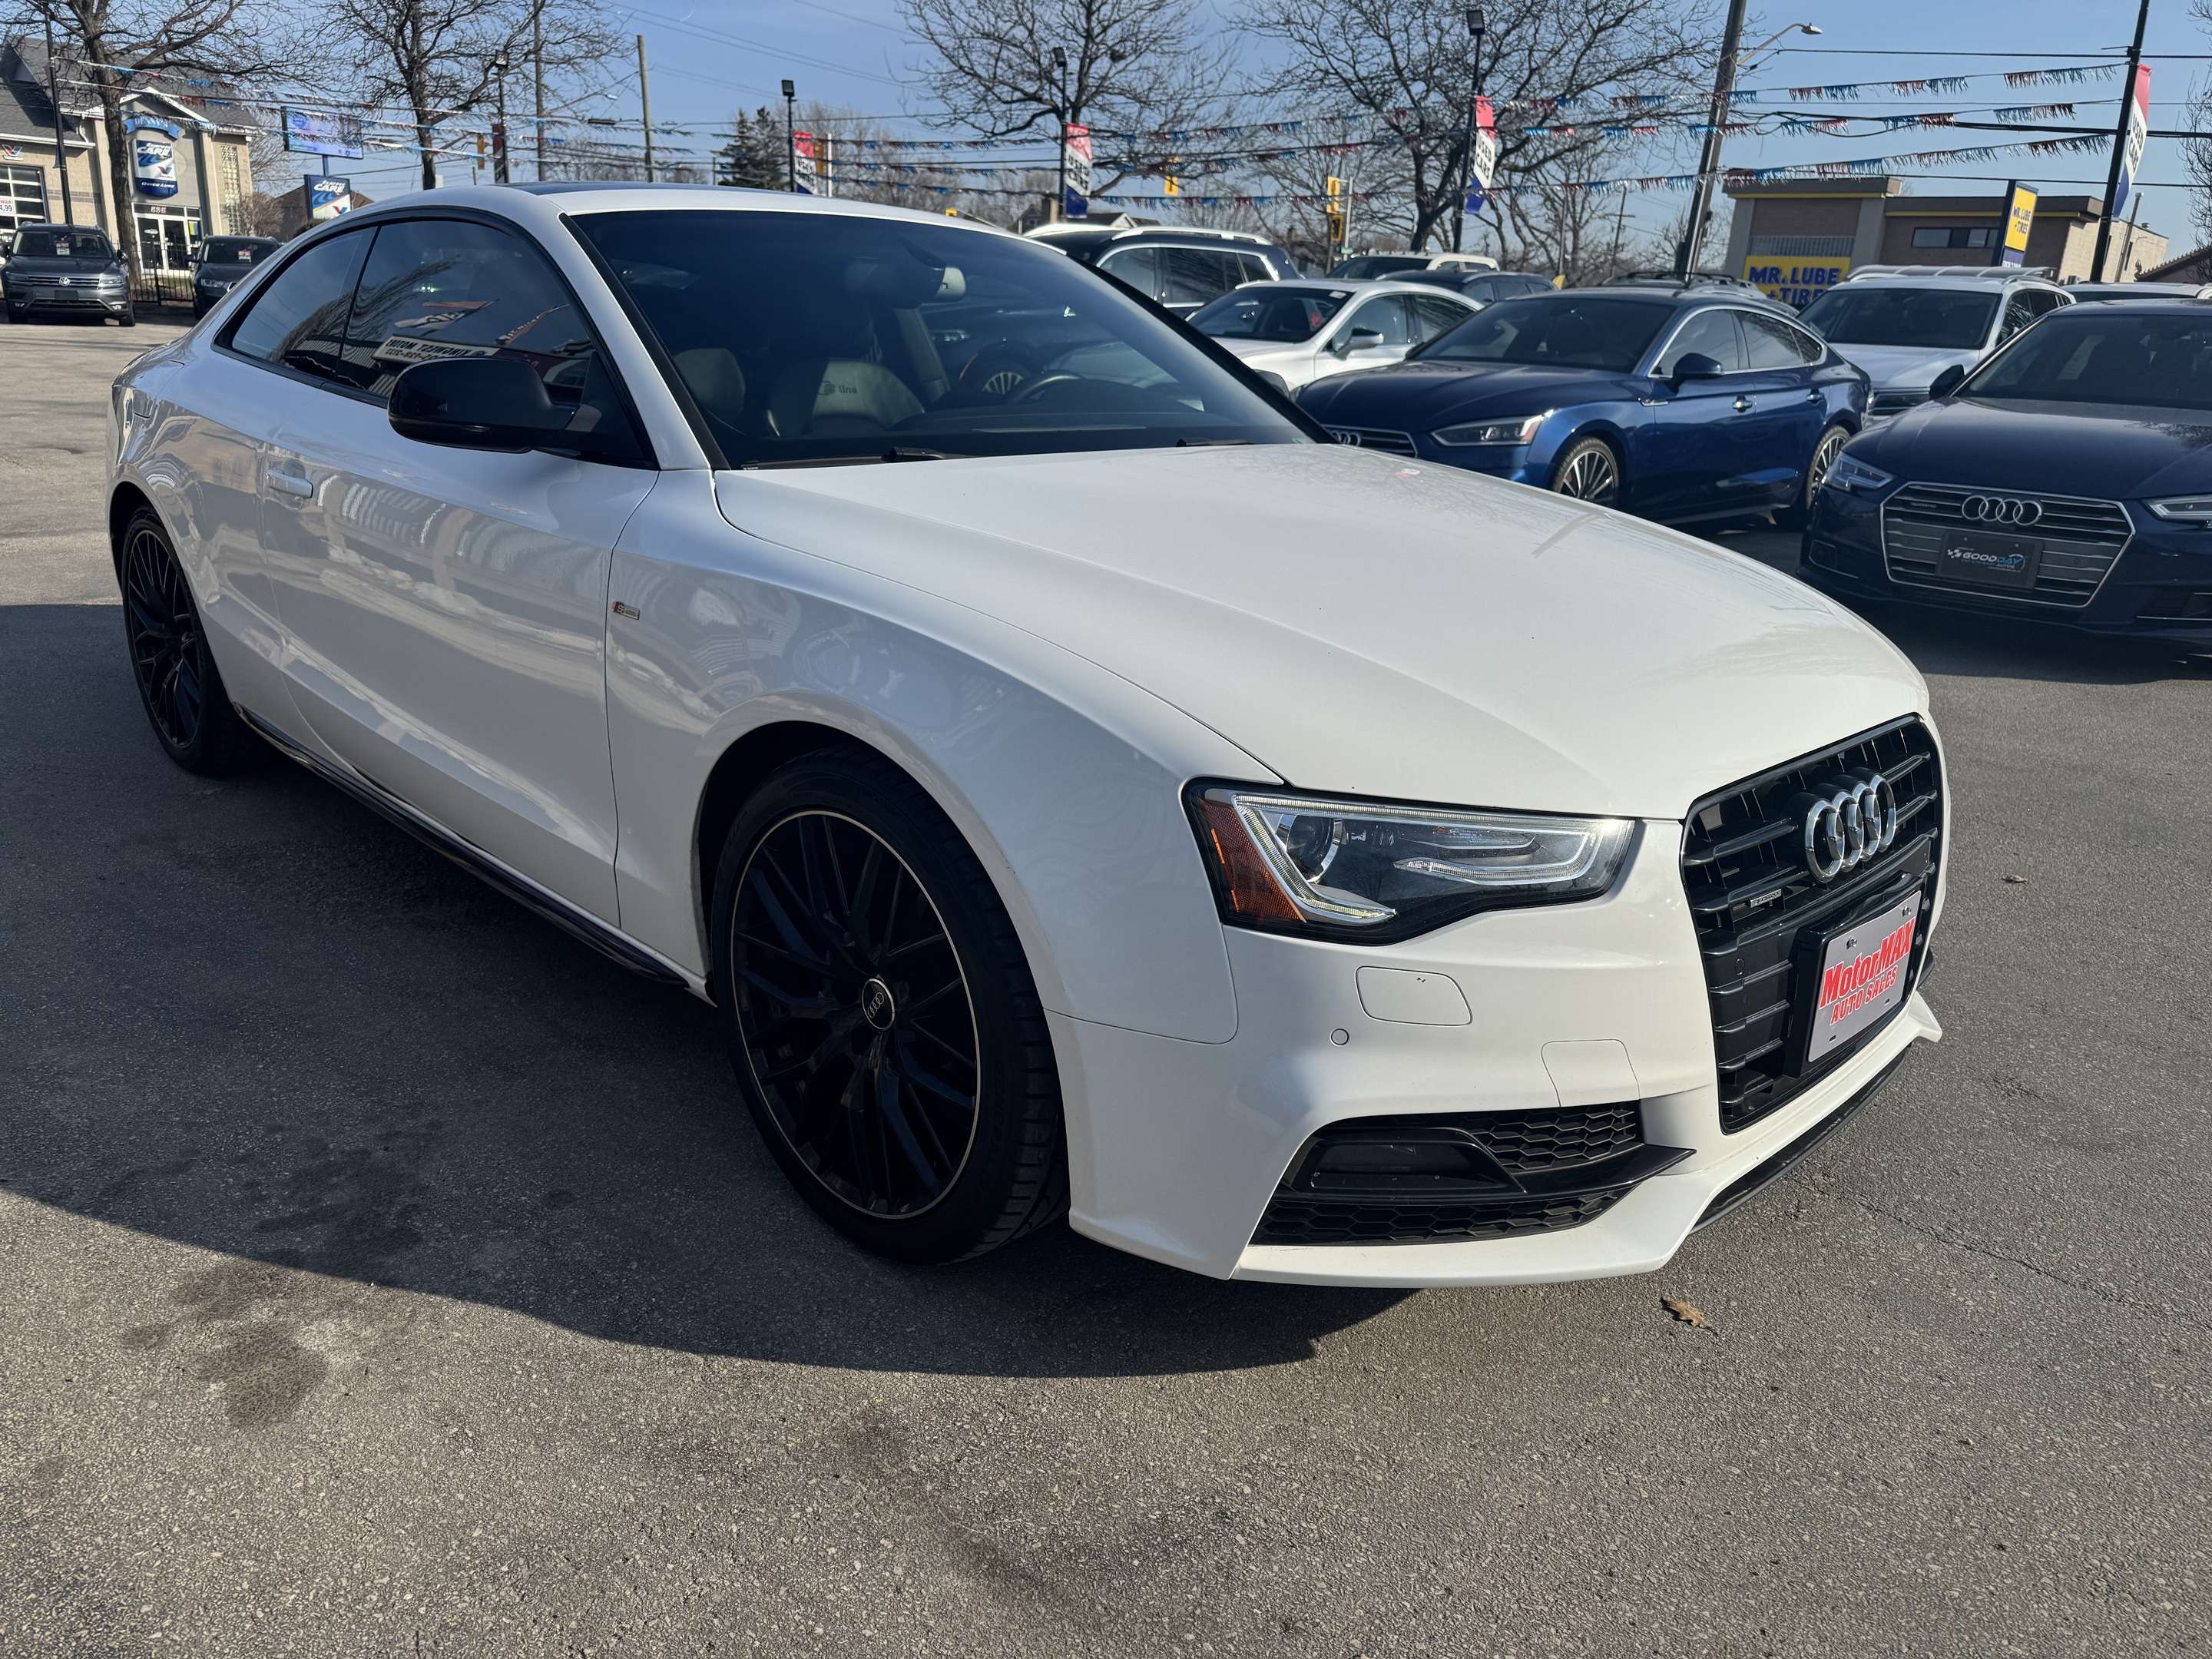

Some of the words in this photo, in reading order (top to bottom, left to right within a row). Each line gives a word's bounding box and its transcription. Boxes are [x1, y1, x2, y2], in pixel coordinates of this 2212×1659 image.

[1478, 135, 1492, 163] USED
[2132, 114, 2144, 151] USED
[1475, 153, 1491, 180] CARS
[2128, 137, 2139, 173] CARS
[1749, 267, 1786, 284] MR.
[1790, 267, 1840, 285] LUBE
[1818, 916, 1916, 1010] MotorMAX
[1830, 988, 1864, 1026] AUTO
[1864, 965, 1899, 1005] SALES
